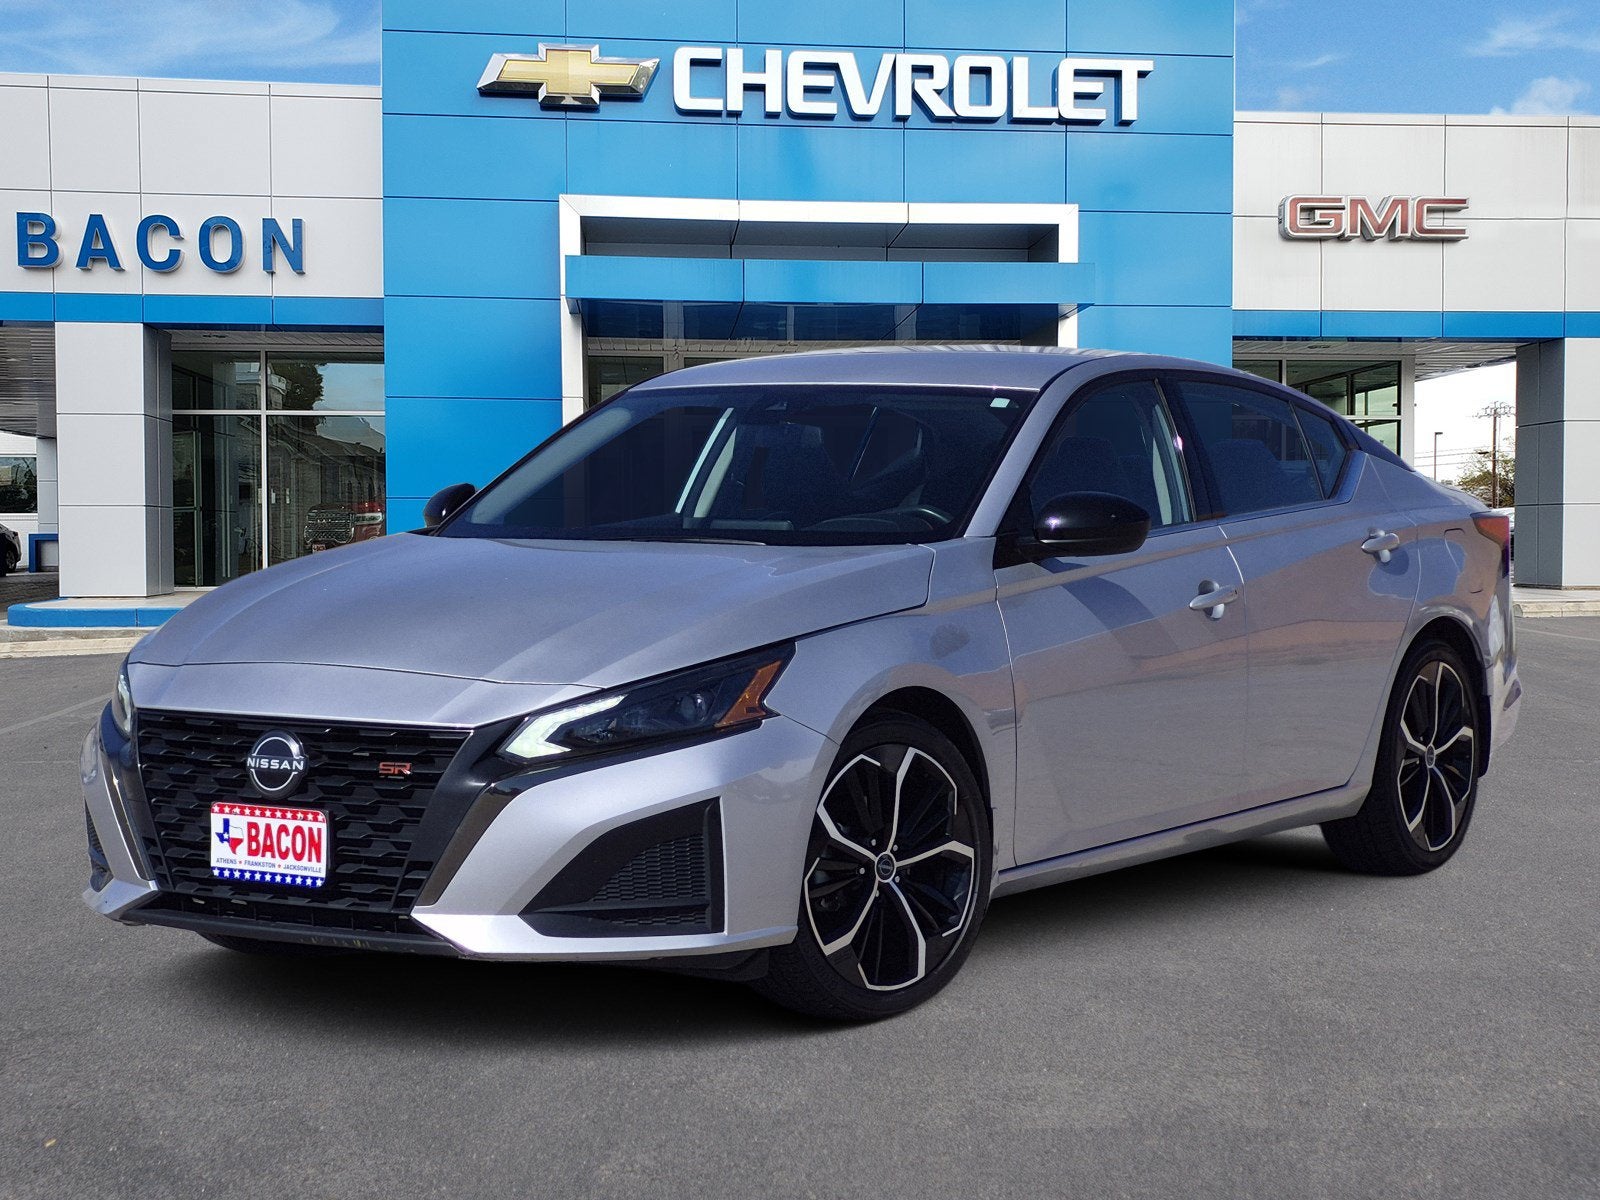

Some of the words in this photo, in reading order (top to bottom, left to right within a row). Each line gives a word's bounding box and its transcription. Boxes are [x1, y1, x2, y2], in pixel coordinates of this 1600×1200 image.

[672, 46, 1154, 123] CHEVROLET
[1279, 195, 1469, 242] GMC
[15, 211, 305, 275] BACON
[246, 757, 304, 771] NISSAN
[378, 761, 412, 775] SR
[246, 821, 323, 863] BACON
[215, 857, 238, 866] ATHENS
[243, 859, 276, 869] FRANKSTON
[282, 863, 323, 874] JACKSONVILLE
